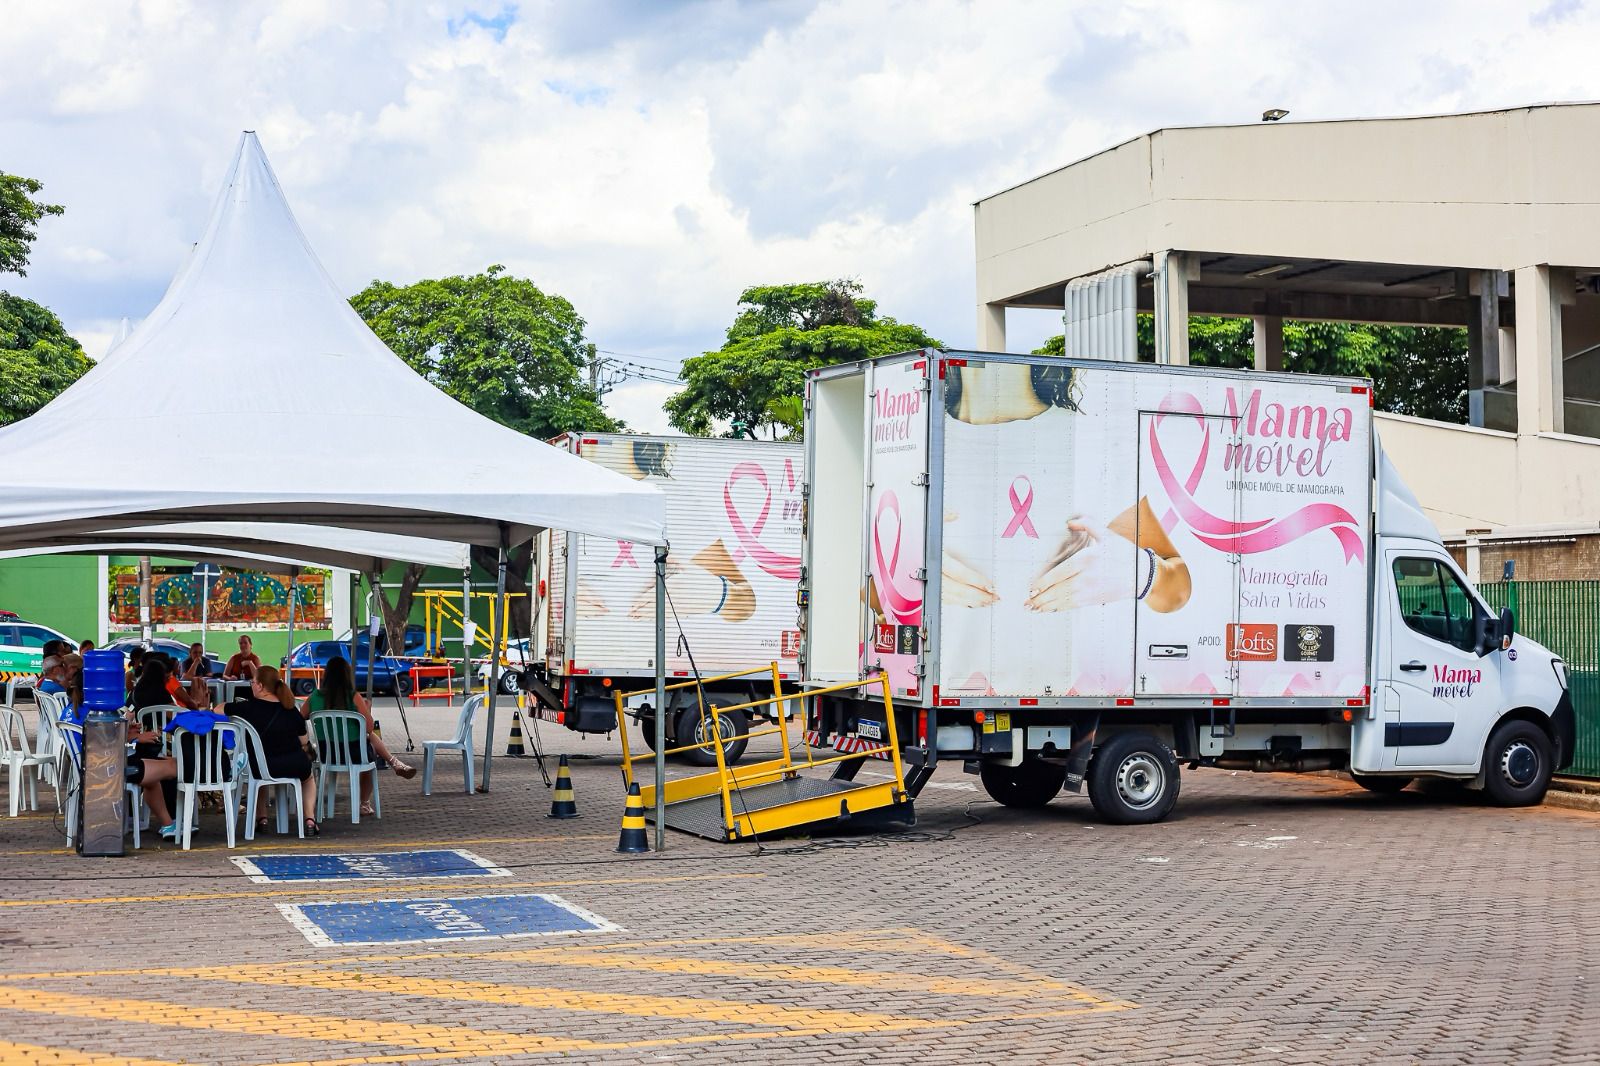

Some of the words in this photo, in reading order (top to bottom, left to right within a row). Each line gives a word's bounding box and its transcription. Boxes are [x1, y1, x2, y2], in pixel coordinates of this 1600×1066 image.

[874, 388, 920, 418] Mama
[1220, 387, 1353, 442] Mama
[1223, 422, 1332, 478] móvel
[1226, 480, 1257, 491] UNIDADE
[1259, 481, 1284, 493] MÓVEL
[1286, 483, 1296, 493] DE
[1297, 483, 1345, 495] MAMOGRAFIA
[1240, 567, 1328, 588] Mamografia
[1240, 590, 1280, 608] Salva
[1288, 591, 1327, 609] Vidas
[1432, 664, 1482, 684] Mama
[1432, 675, 1474, 698] móvel
